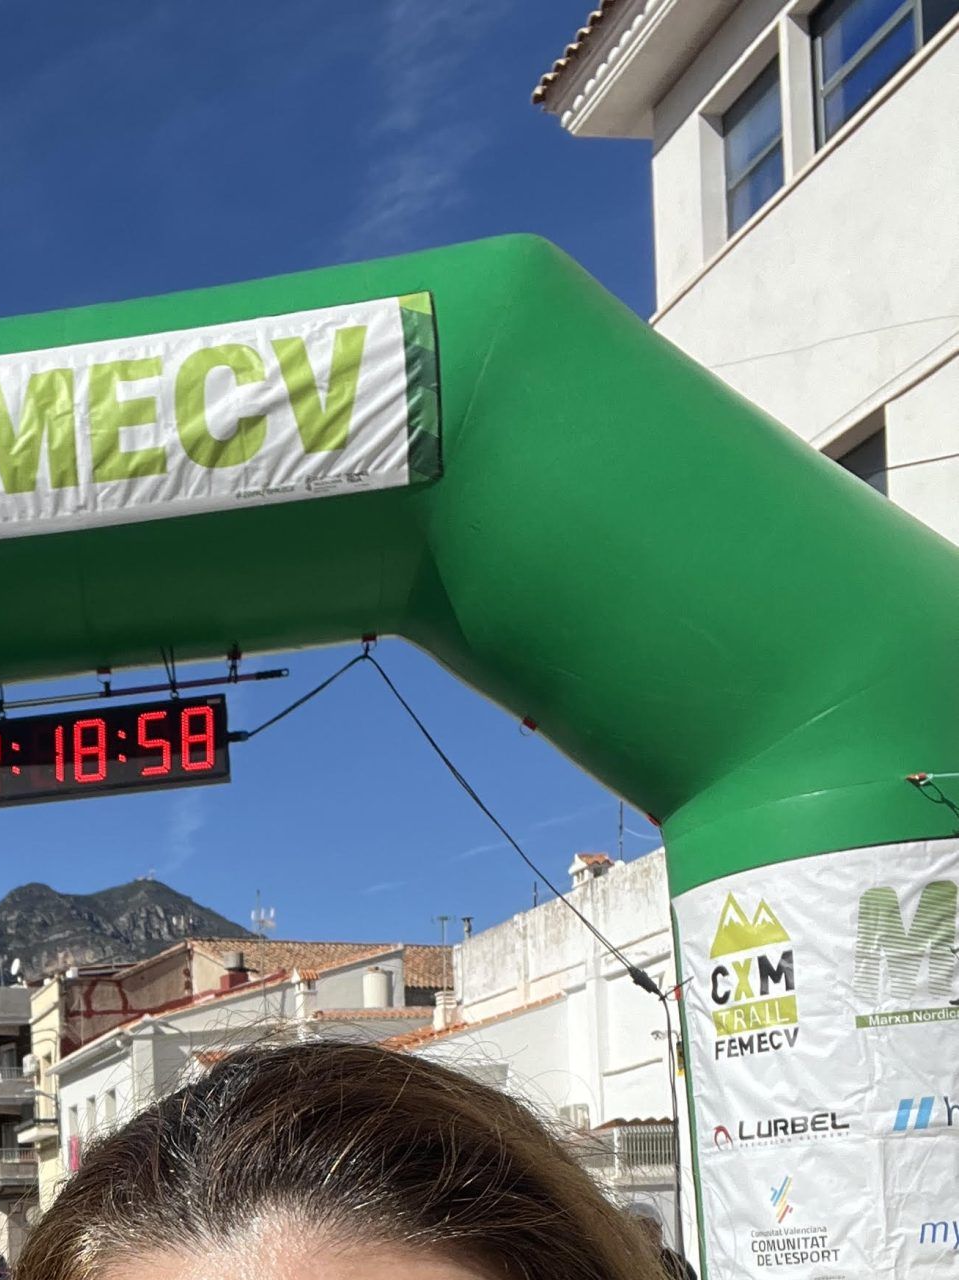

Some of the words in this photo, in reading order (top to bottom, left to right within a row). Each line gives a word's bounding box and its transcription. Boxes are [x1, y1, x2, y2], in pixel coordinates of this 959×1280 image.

[711, 950, 795, 1005] CXM
[718, 1000, 790, 1031] TRAIL
[868, 1011, 909, 1026] Marxa
[715, 1027, 799, 1060] FEMECV
[739, 1112, 850, 1140] LURBEL
[784, 1226, 827, 1236] Valenciana
[751, 1236, 828, 1253] COMUNITAT
[757, 1254, 772, 1267] DE
[775, 1249, 840, 1266] L'ESPORT
